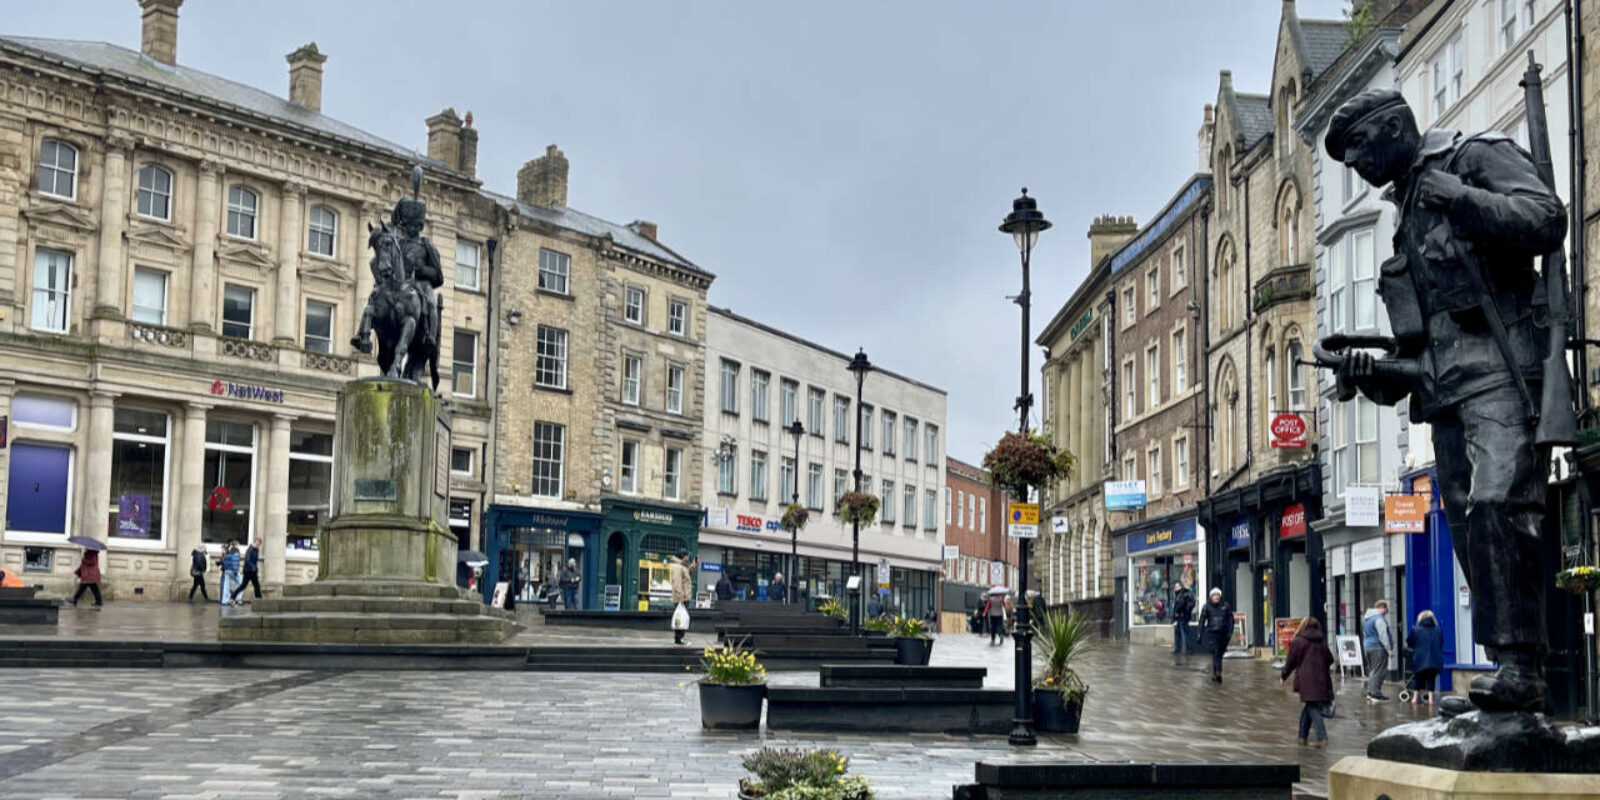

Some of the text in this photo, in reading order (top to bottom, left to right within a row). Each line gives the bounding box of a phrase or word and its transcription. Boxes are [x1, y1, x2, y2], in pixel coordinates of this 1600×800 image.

[228, 383, 283, 403] NatWest
[1275, 425, 1300, 434] OFFICE
[736, 514, 762, 528] TESCO
[1282, 514, 1294, 527] POST
[1146, 530, 1172, 544] Card Factory
